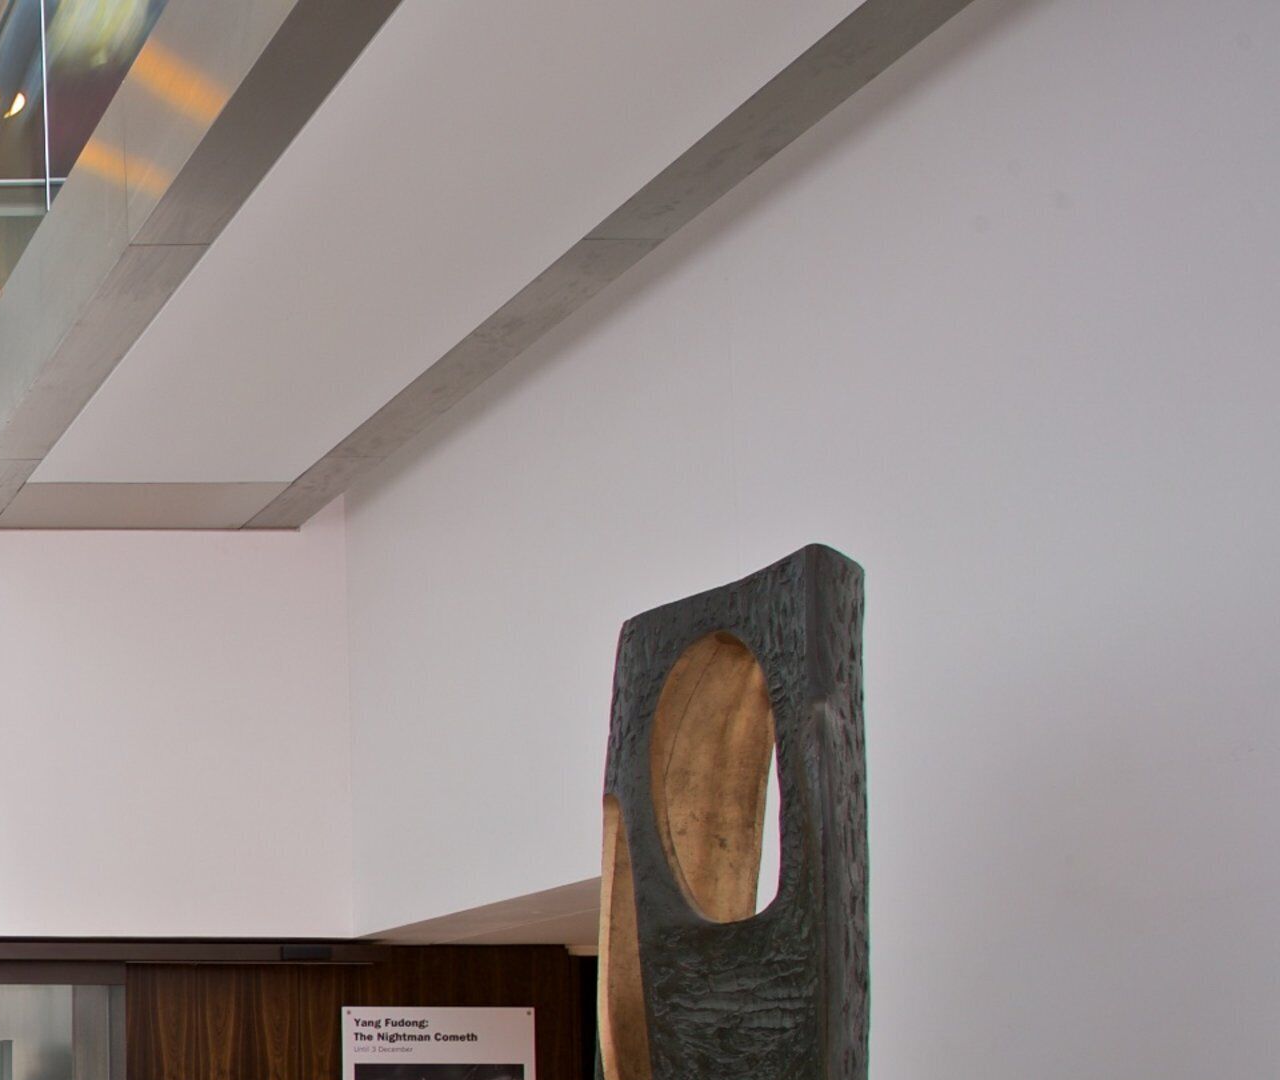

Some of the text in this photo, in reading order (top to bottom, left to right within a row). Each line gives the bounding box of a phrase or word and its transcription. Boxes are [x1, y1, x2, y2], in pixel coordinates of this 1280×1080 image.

[354, 1018, 429, 1029] Yang Fudong:
[354, 1032, 478, 1043] The Nightman Cometh
